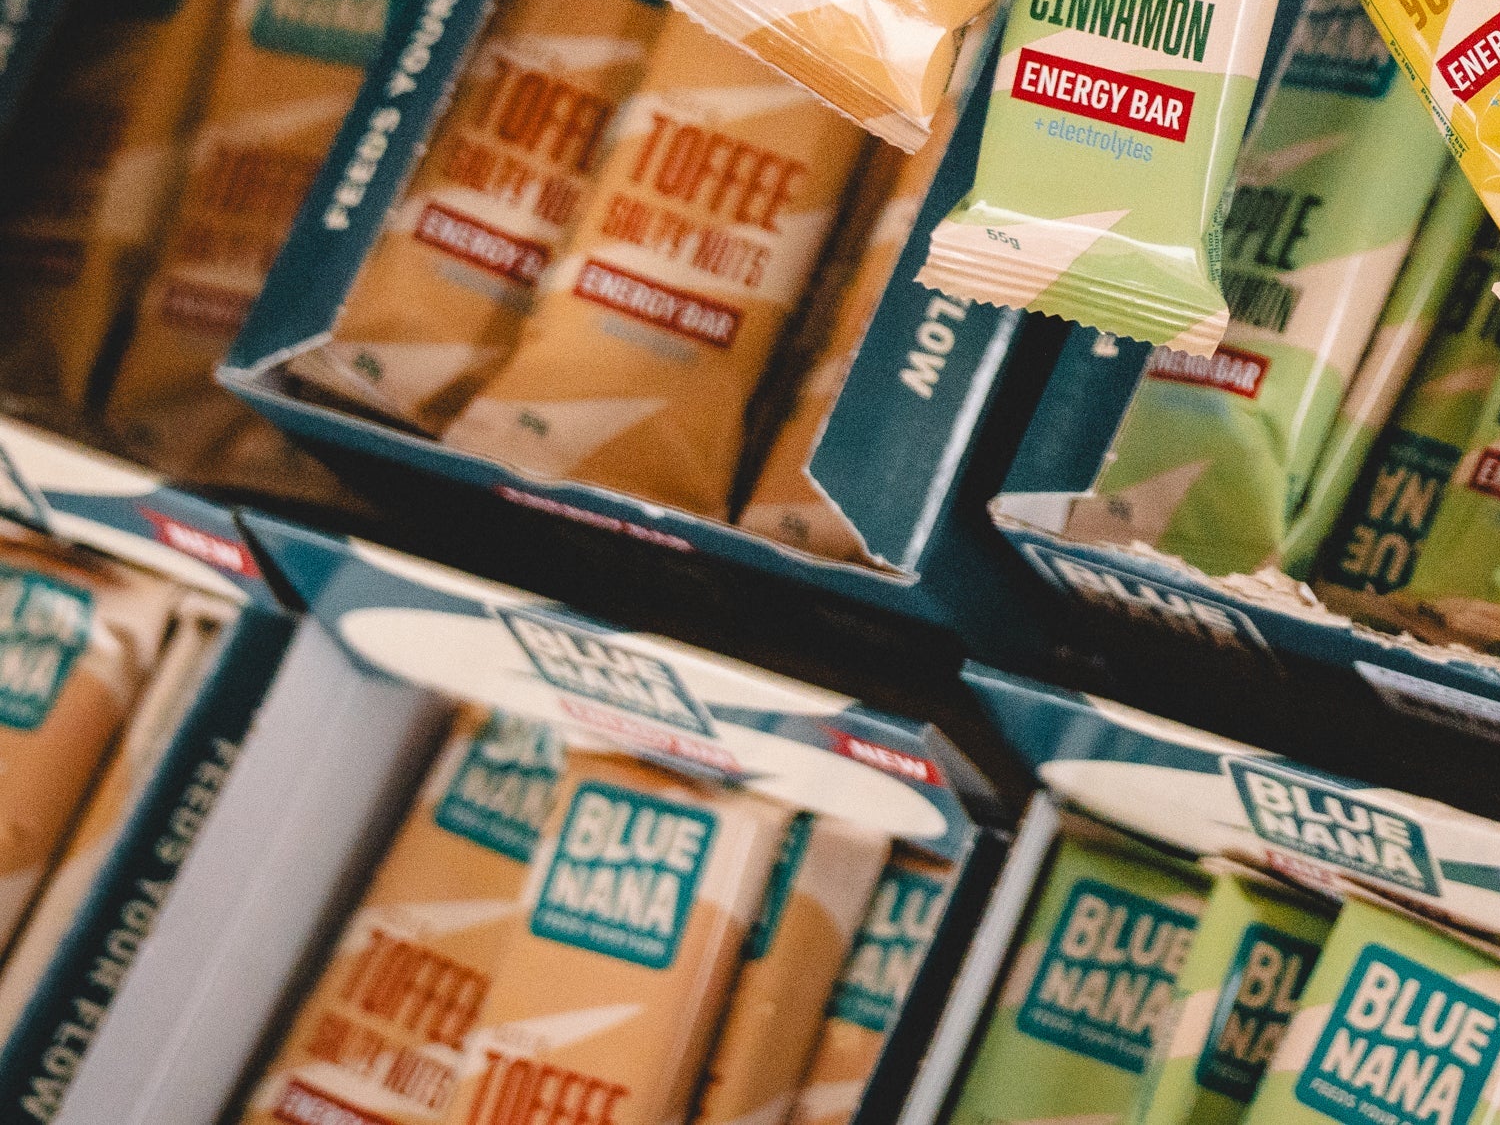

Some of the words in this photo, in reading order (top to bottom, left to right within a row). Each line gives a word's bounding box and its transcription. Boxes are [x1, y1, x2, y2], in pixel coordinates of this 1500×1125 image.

[1020, 60, 1129, 115] ENERGY
[1129, 90, 1184, 131] BAR
[629, 111, 809, 232] TOFFEE
[1047, 117, 1154, 163] electrolytes
[986, 228, 1021, 251] 55g
[580, 264, 677, 321] ENERGY
[899, 294, 973, 400] LOW
[849, 737, 928, 779] NEW
[566, 791, 707, 874] BLUE
[1246, 771, 1413, 850] BLUE
[1256, 808, 1425, 880] NANA
[550, 858, 681, 937] NANA
[1060, 892, 1196, 976] BLUE
[1039, 959, 1174, 1033] NANA
[1237, 940, 1303, 1015] BL
[1343, 959, 1498, 1068] BLUE
[1219, 1012, 1288, 1066] NA
[1319, 1027, 1465, 1125] NANA
